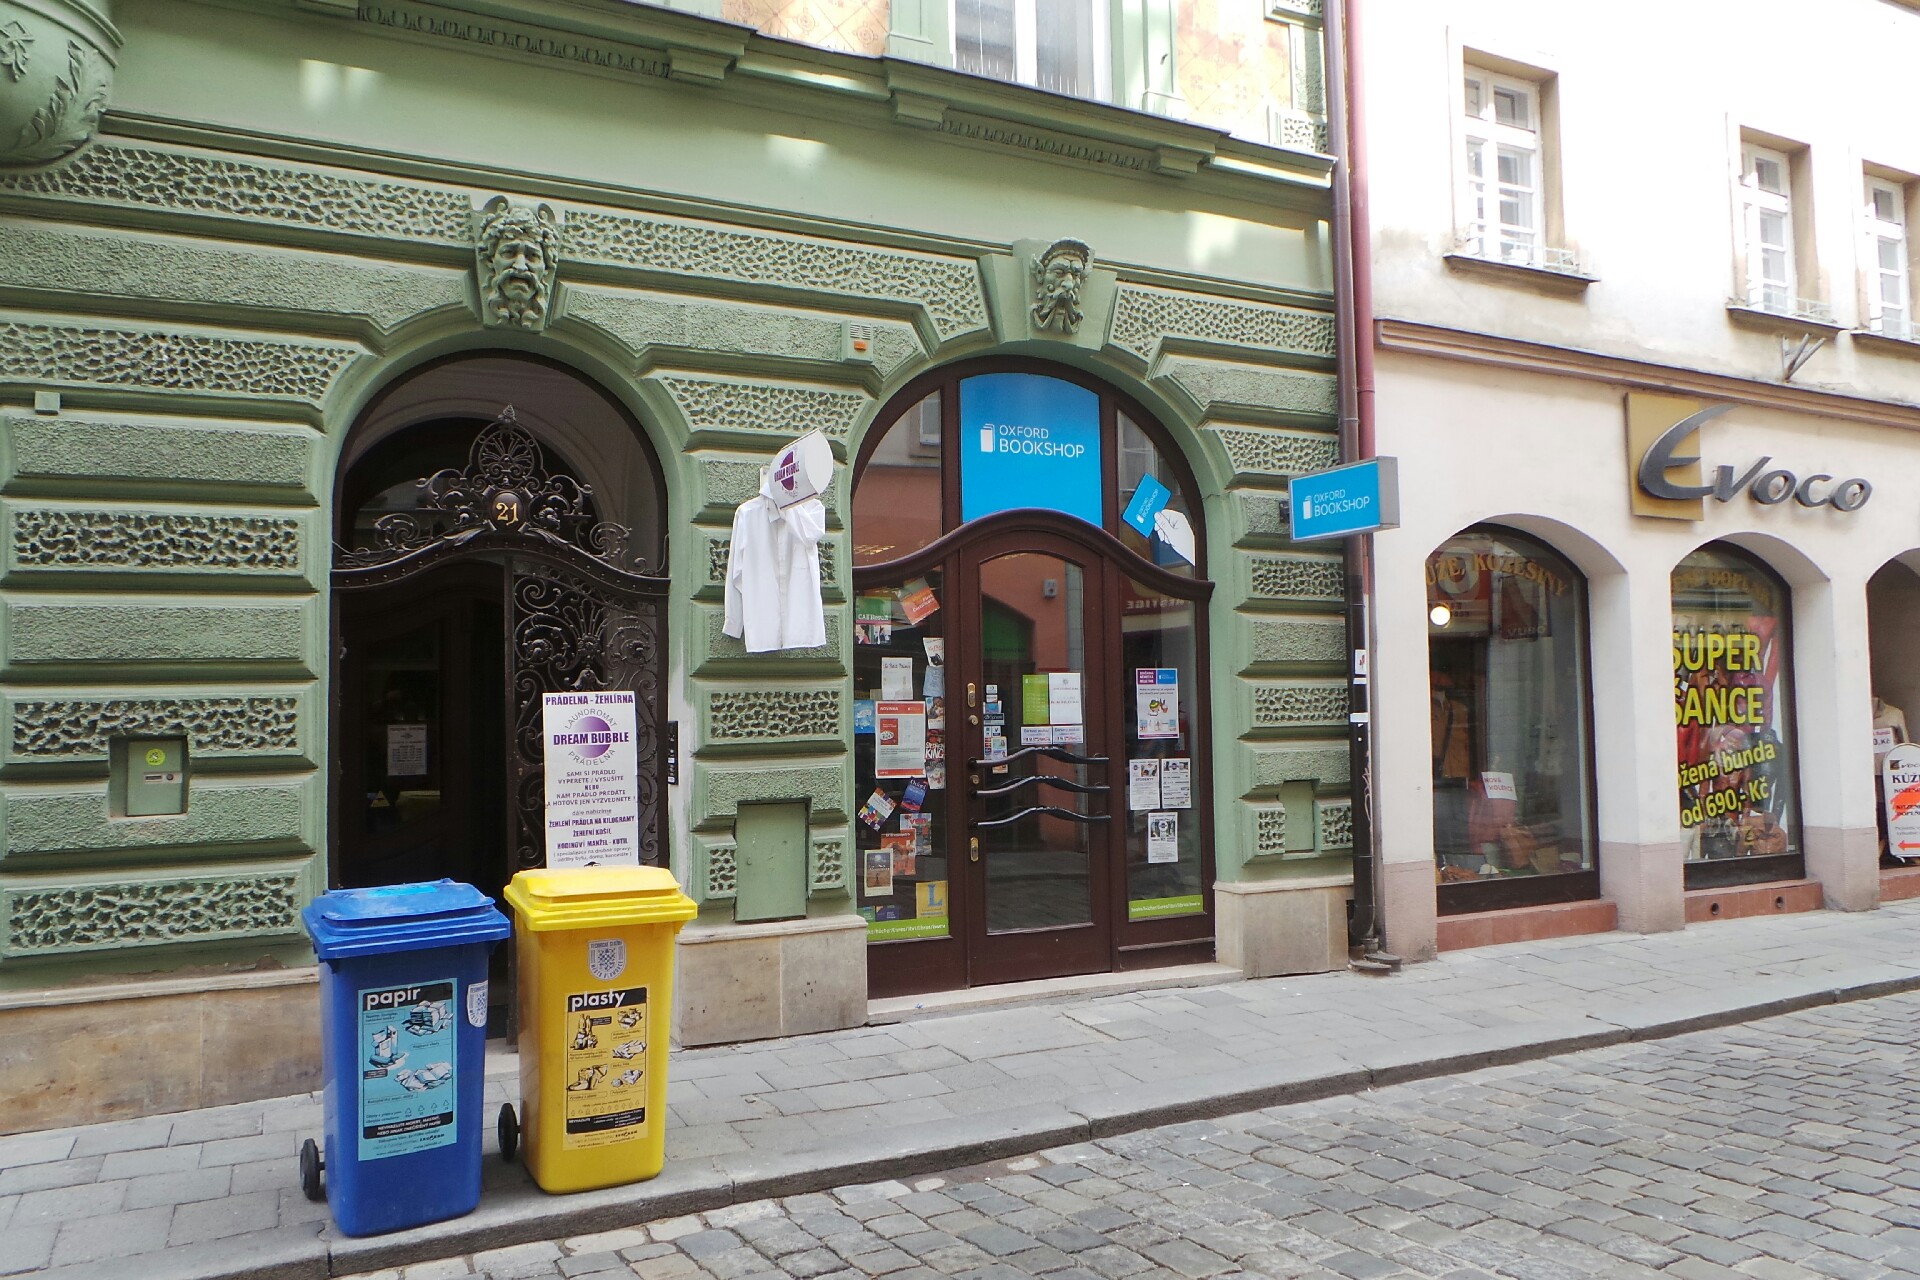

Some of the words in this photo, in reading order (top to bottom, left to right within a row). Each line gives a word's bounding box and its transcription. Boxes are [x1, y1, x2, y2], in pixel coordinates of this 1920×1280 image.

[999, 424, 1049, 439] OXFORD
[999, 438, 1085, 458] BOOKSHOP
[1638, 402, 1873, 512] Evoco
[1313, 489, 1346, 504] OXFORD
[1314, 496, 1370, 517] BOOKSHOP
[496, 502, 519, 526] 21
[1672, 633, 1762, 671] SUPER
[545, 694, 589, 706] PRÁDELNA
[595, 694, 634, 704] ŽEHLÍRNA
[564, 708, 618, 730] LAUNDROMAT
[553, 734, 589, 746] DREAM
[591, 732, 629, 744] BUBBLE
[567, 748, 616, 767] PRÁDELNA
[925, 748, 944, 759] KING
[1722, 740, 1776, 773] bunda
[1892, 773, 1920, 784] KŮŽ
[1681, 798, 1704, 826] od
[1706, 788, 1746, 817] 690,-
[1748, 776, 1769, 802] Kč
[594, 817, 602, 825] NA
[367, 985, 421, 1011] papír
[571, 989, 626, 1012] plasty
